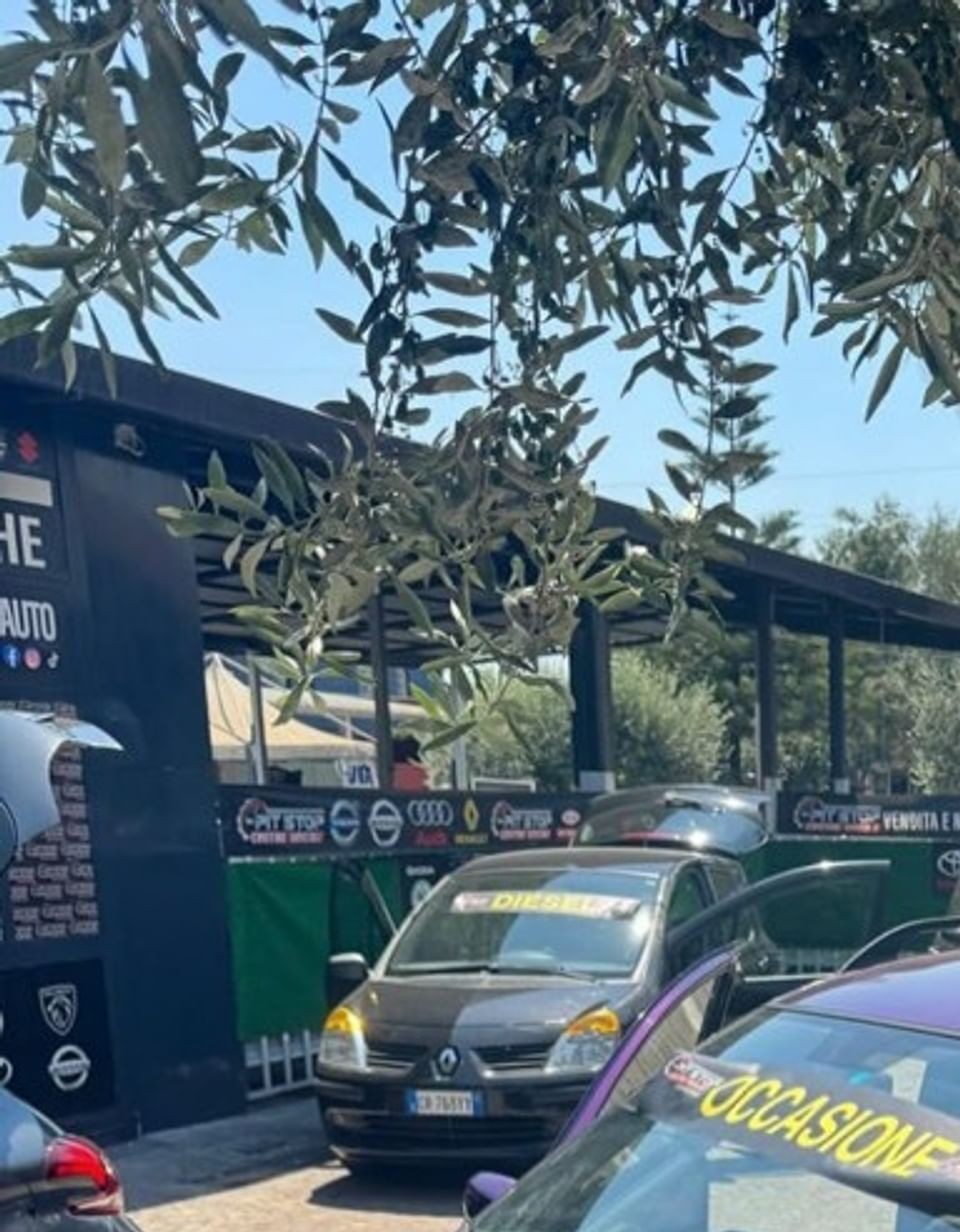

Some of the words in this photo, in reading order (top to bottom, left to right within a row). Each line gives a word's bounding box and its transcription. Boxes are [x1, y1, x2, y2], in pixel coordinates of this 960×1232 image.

[0, 597, 57, 641] AUTO
[882, 811, 939, 831] VENDITA
[942, 811, 950, 831] E
[700, 1075, 960, 1177] OCCASIONE
